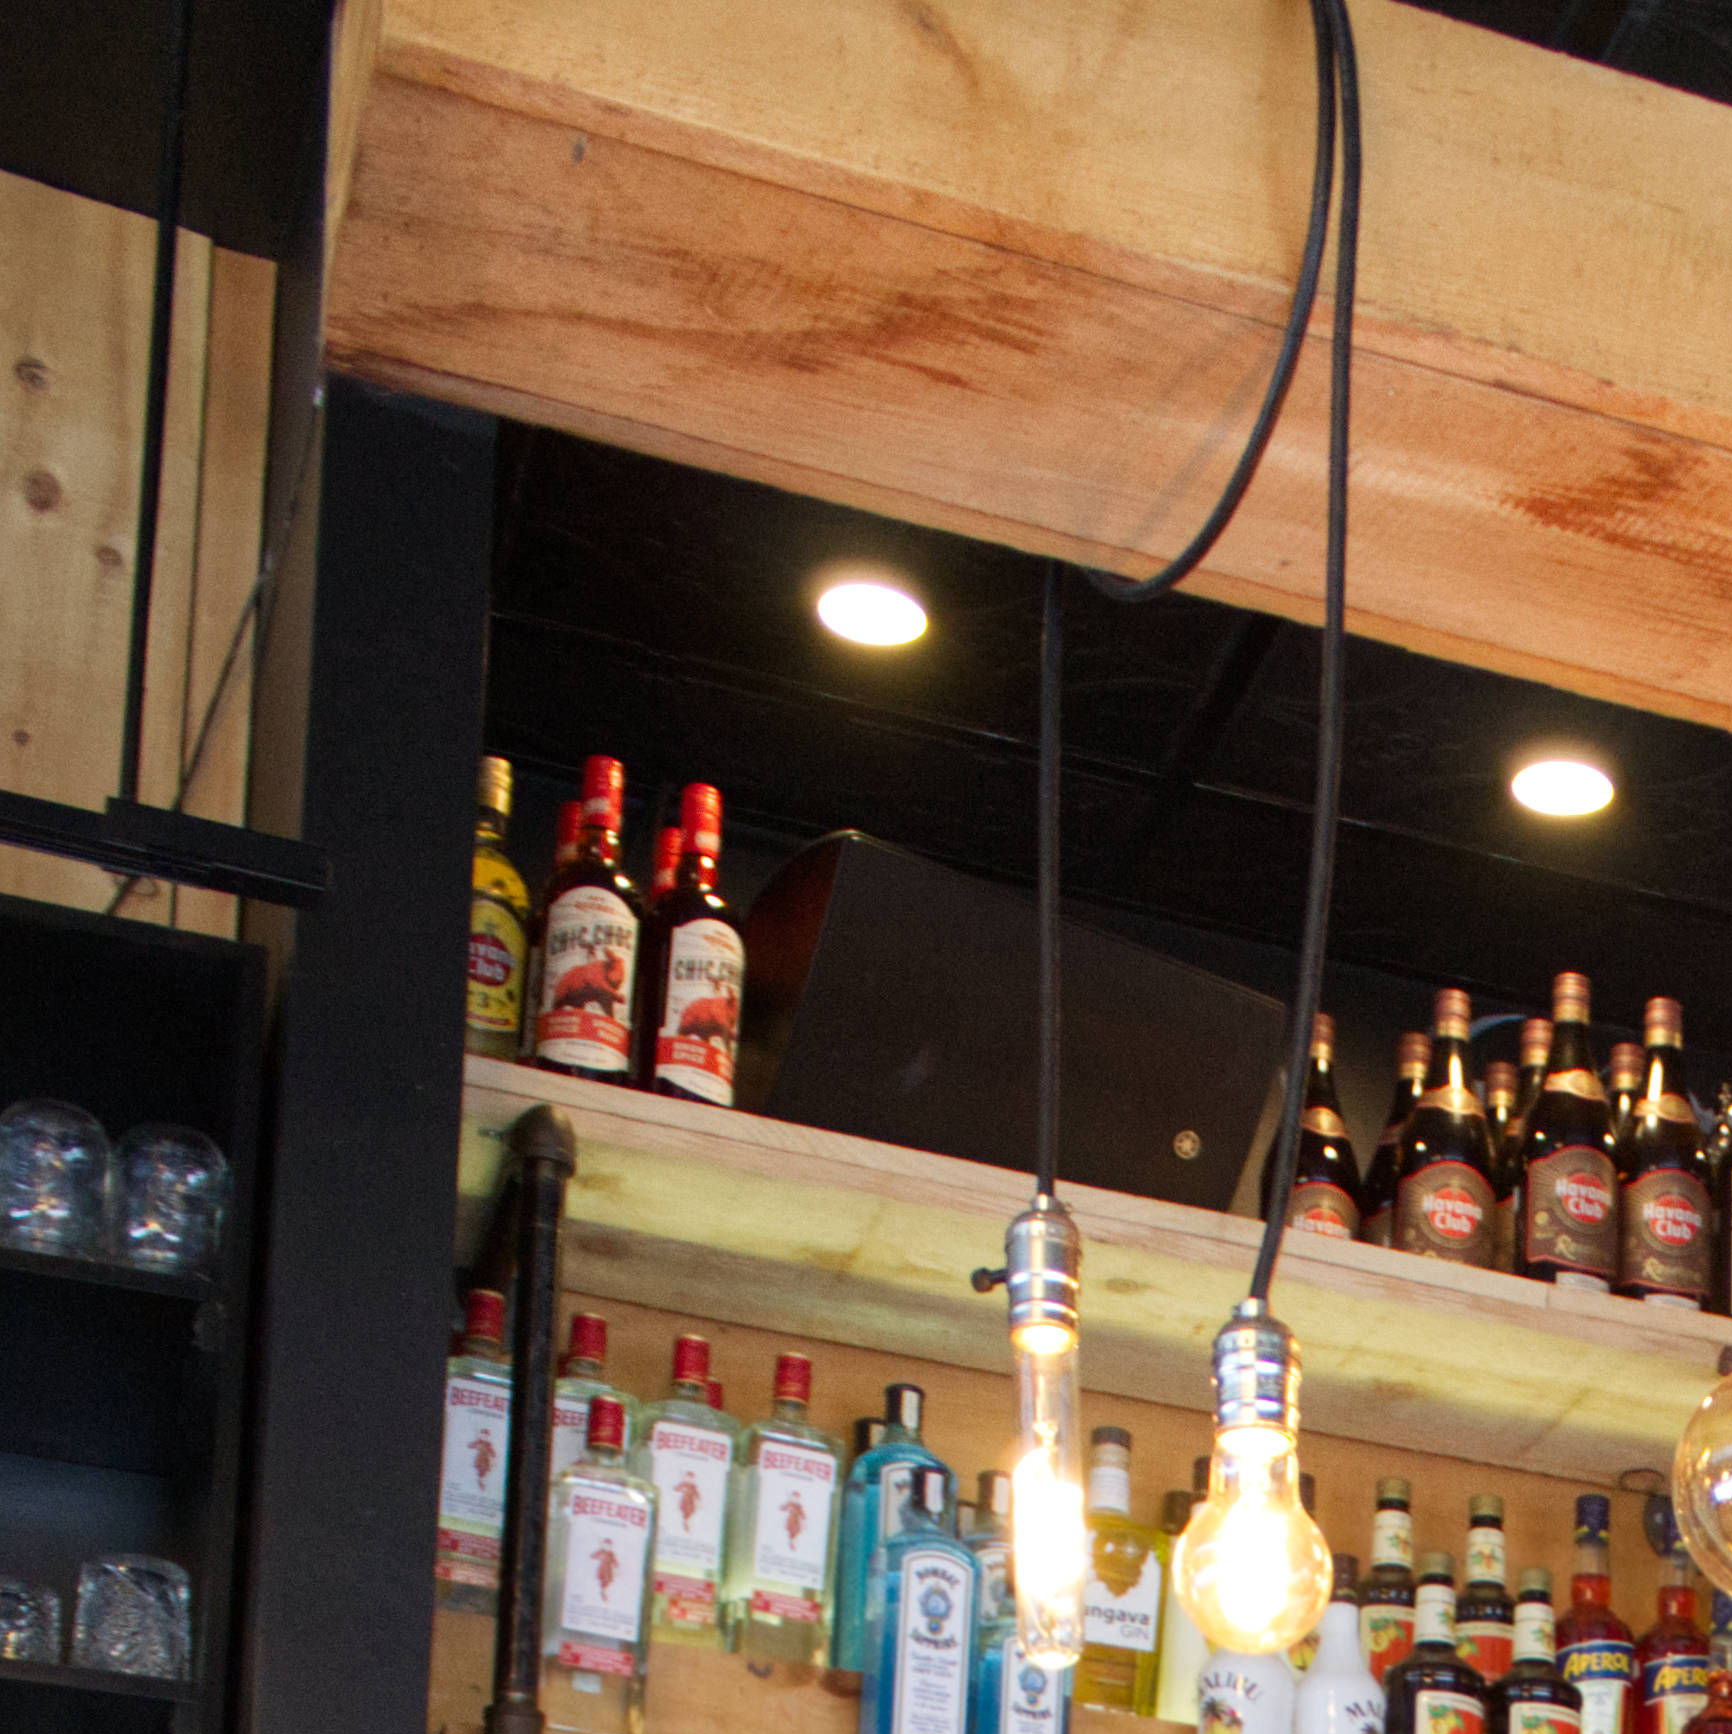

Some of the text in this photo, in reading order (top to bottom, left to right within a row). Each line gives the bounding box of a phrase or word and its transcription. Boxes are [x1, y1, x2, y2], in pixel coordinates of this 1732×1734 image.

[1556, 1177, 1613, 1208] Havana
[1423, 1194, 1483, 1220] Havana
[1568, 1197, 1604, 1220] Club
[1643, 1201, 1701, 1228] Havana
[1434, 1215, 1471, 1234] Club
[1655, 1218, 1693, 1239] Club
[655, 1429, 729, 1463] BEEFEATER
[763, 1449, 837, 1483] BEEFEATER
[571, 1493, 648, 1529] BEEFEATER
[1120, 1624, 1151, 1641] GIN
